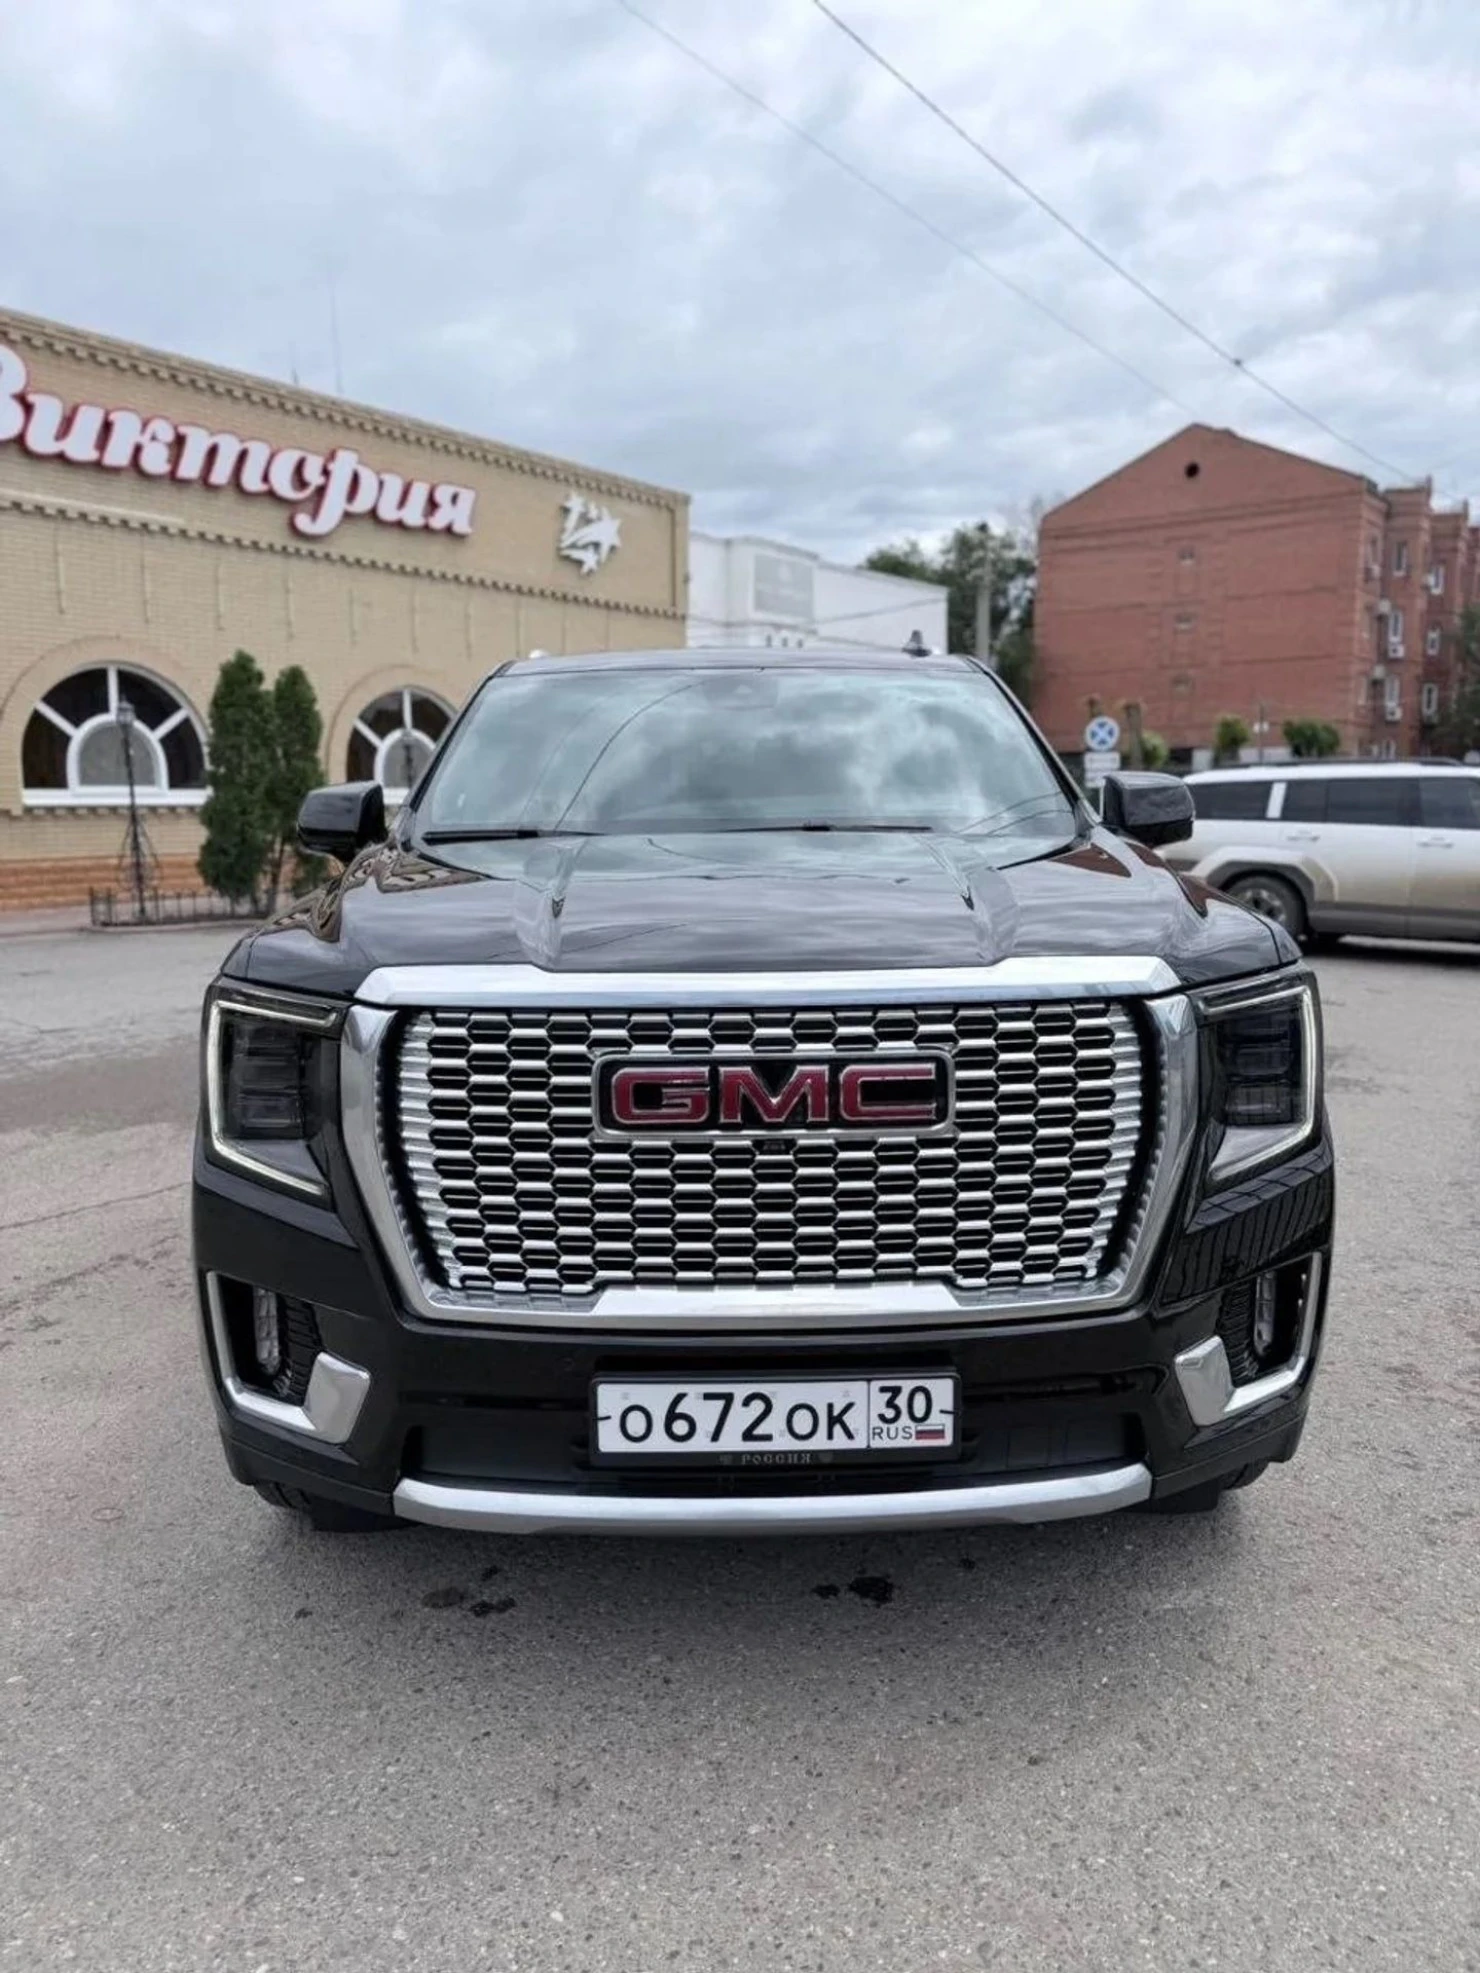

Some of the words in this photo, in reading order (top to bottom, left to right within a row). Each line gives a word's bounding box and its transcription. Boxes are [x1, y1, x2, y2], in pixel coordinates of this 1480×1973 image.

[611, 1063, 936, 1124] GMC
[877, 1386, 933, 1424] 30
[872, 1425, 913, 1441] RUS
[741, 1453, 812, 1465] РОССИЯ
